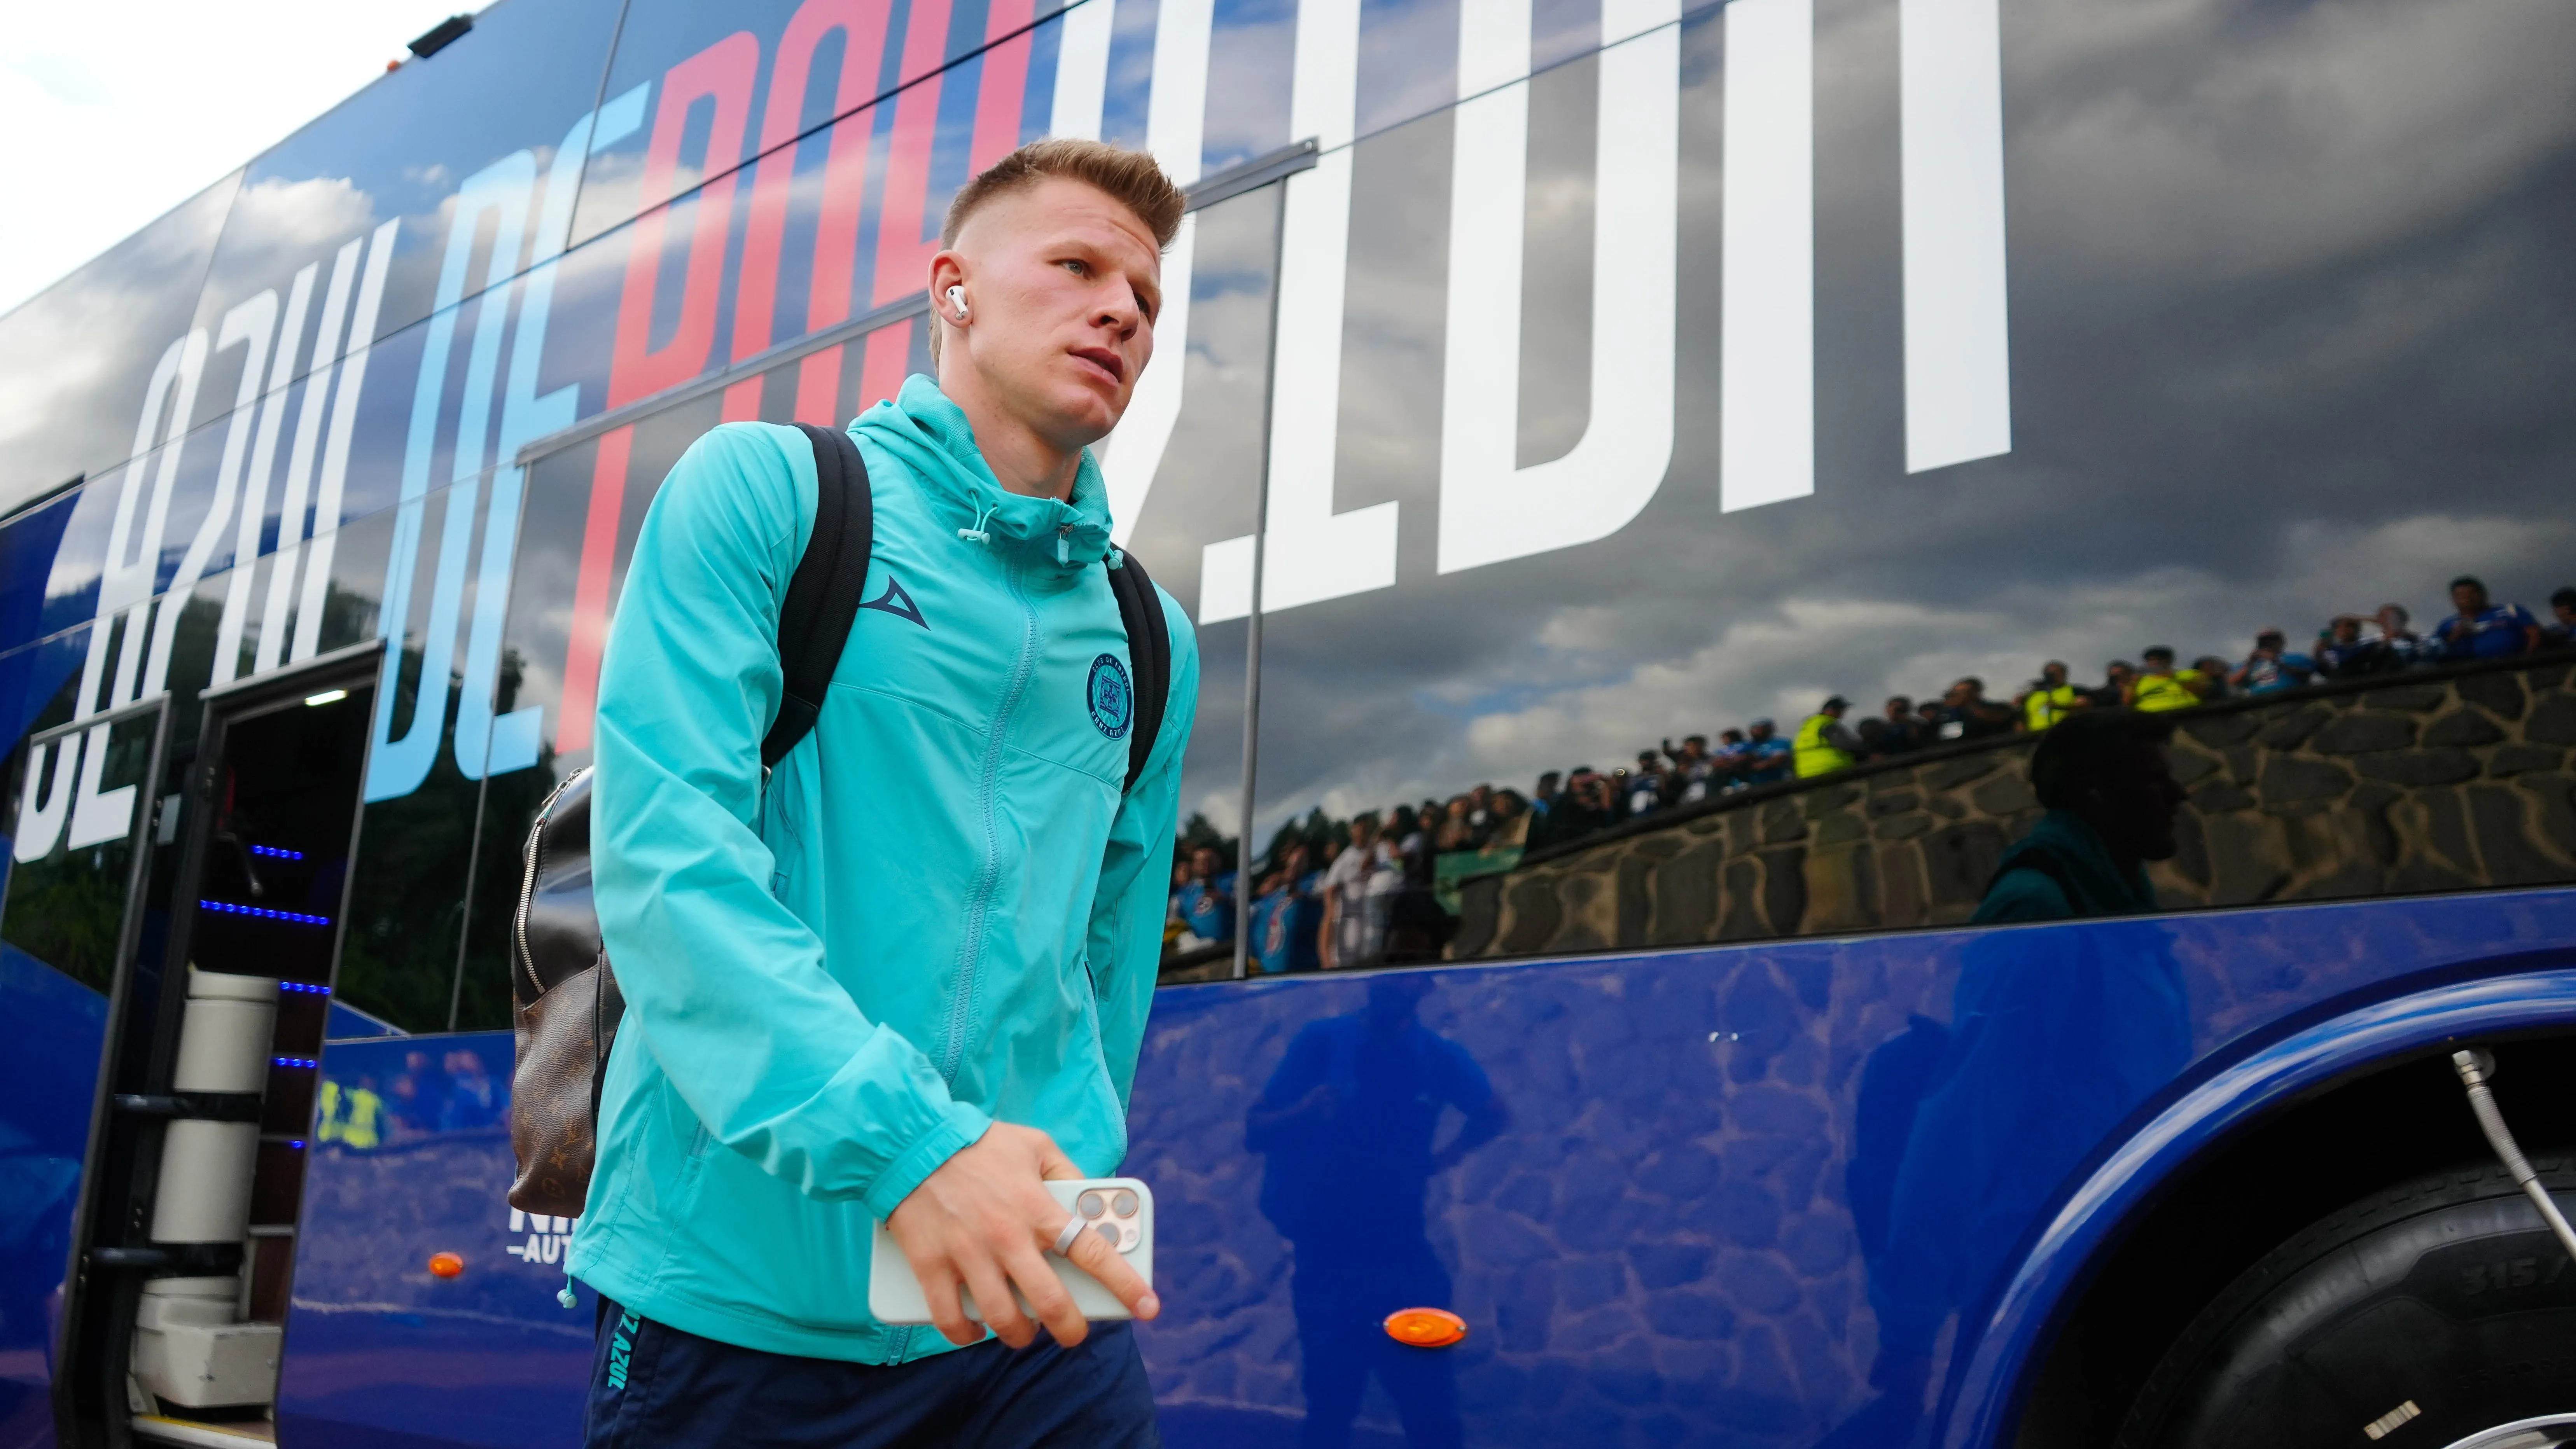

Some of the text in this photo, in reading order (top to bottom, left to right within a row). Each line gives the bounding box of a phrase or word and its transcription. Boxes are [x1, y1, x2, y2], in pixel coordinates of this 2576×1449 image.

[364, 81, 650, 804] DE
[1092, 658, 1104, 673] CLUB
[1091, 711, 1125, 737] CRUZ AZUL
[608, 1332, 631, 1390] AZUL
